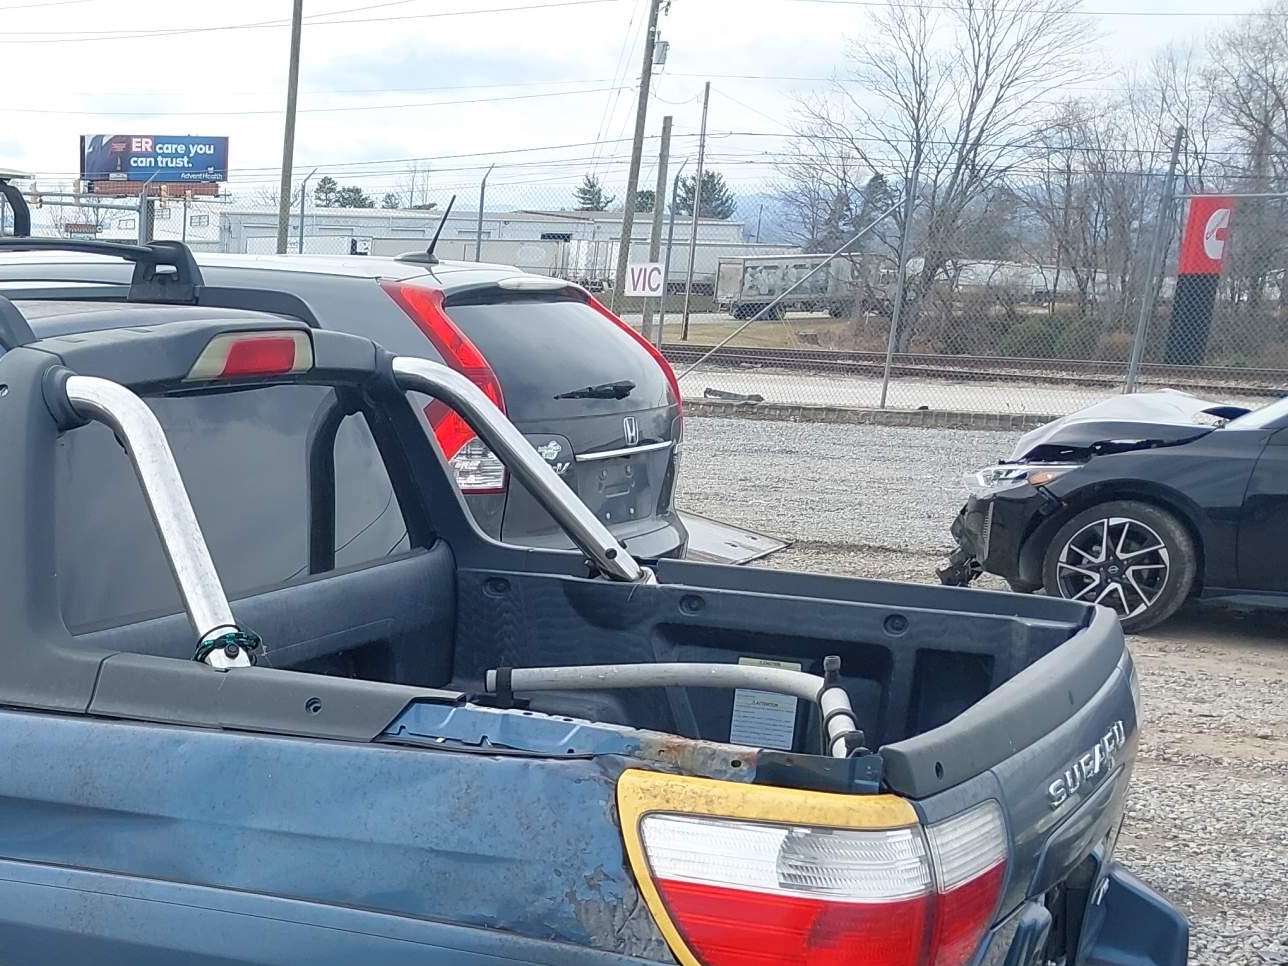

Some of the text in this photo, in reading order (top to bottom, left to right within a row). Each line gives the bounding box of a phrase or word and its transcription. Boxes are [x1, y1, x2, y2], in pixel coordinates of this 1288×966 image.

[131, 138, 153, 152] ER
[156, 143, 185, 154] care
[189, 143, 214, 157] you
[130, 155, 192, 167] can trust.
[630, 266, 662, 292] VIC
